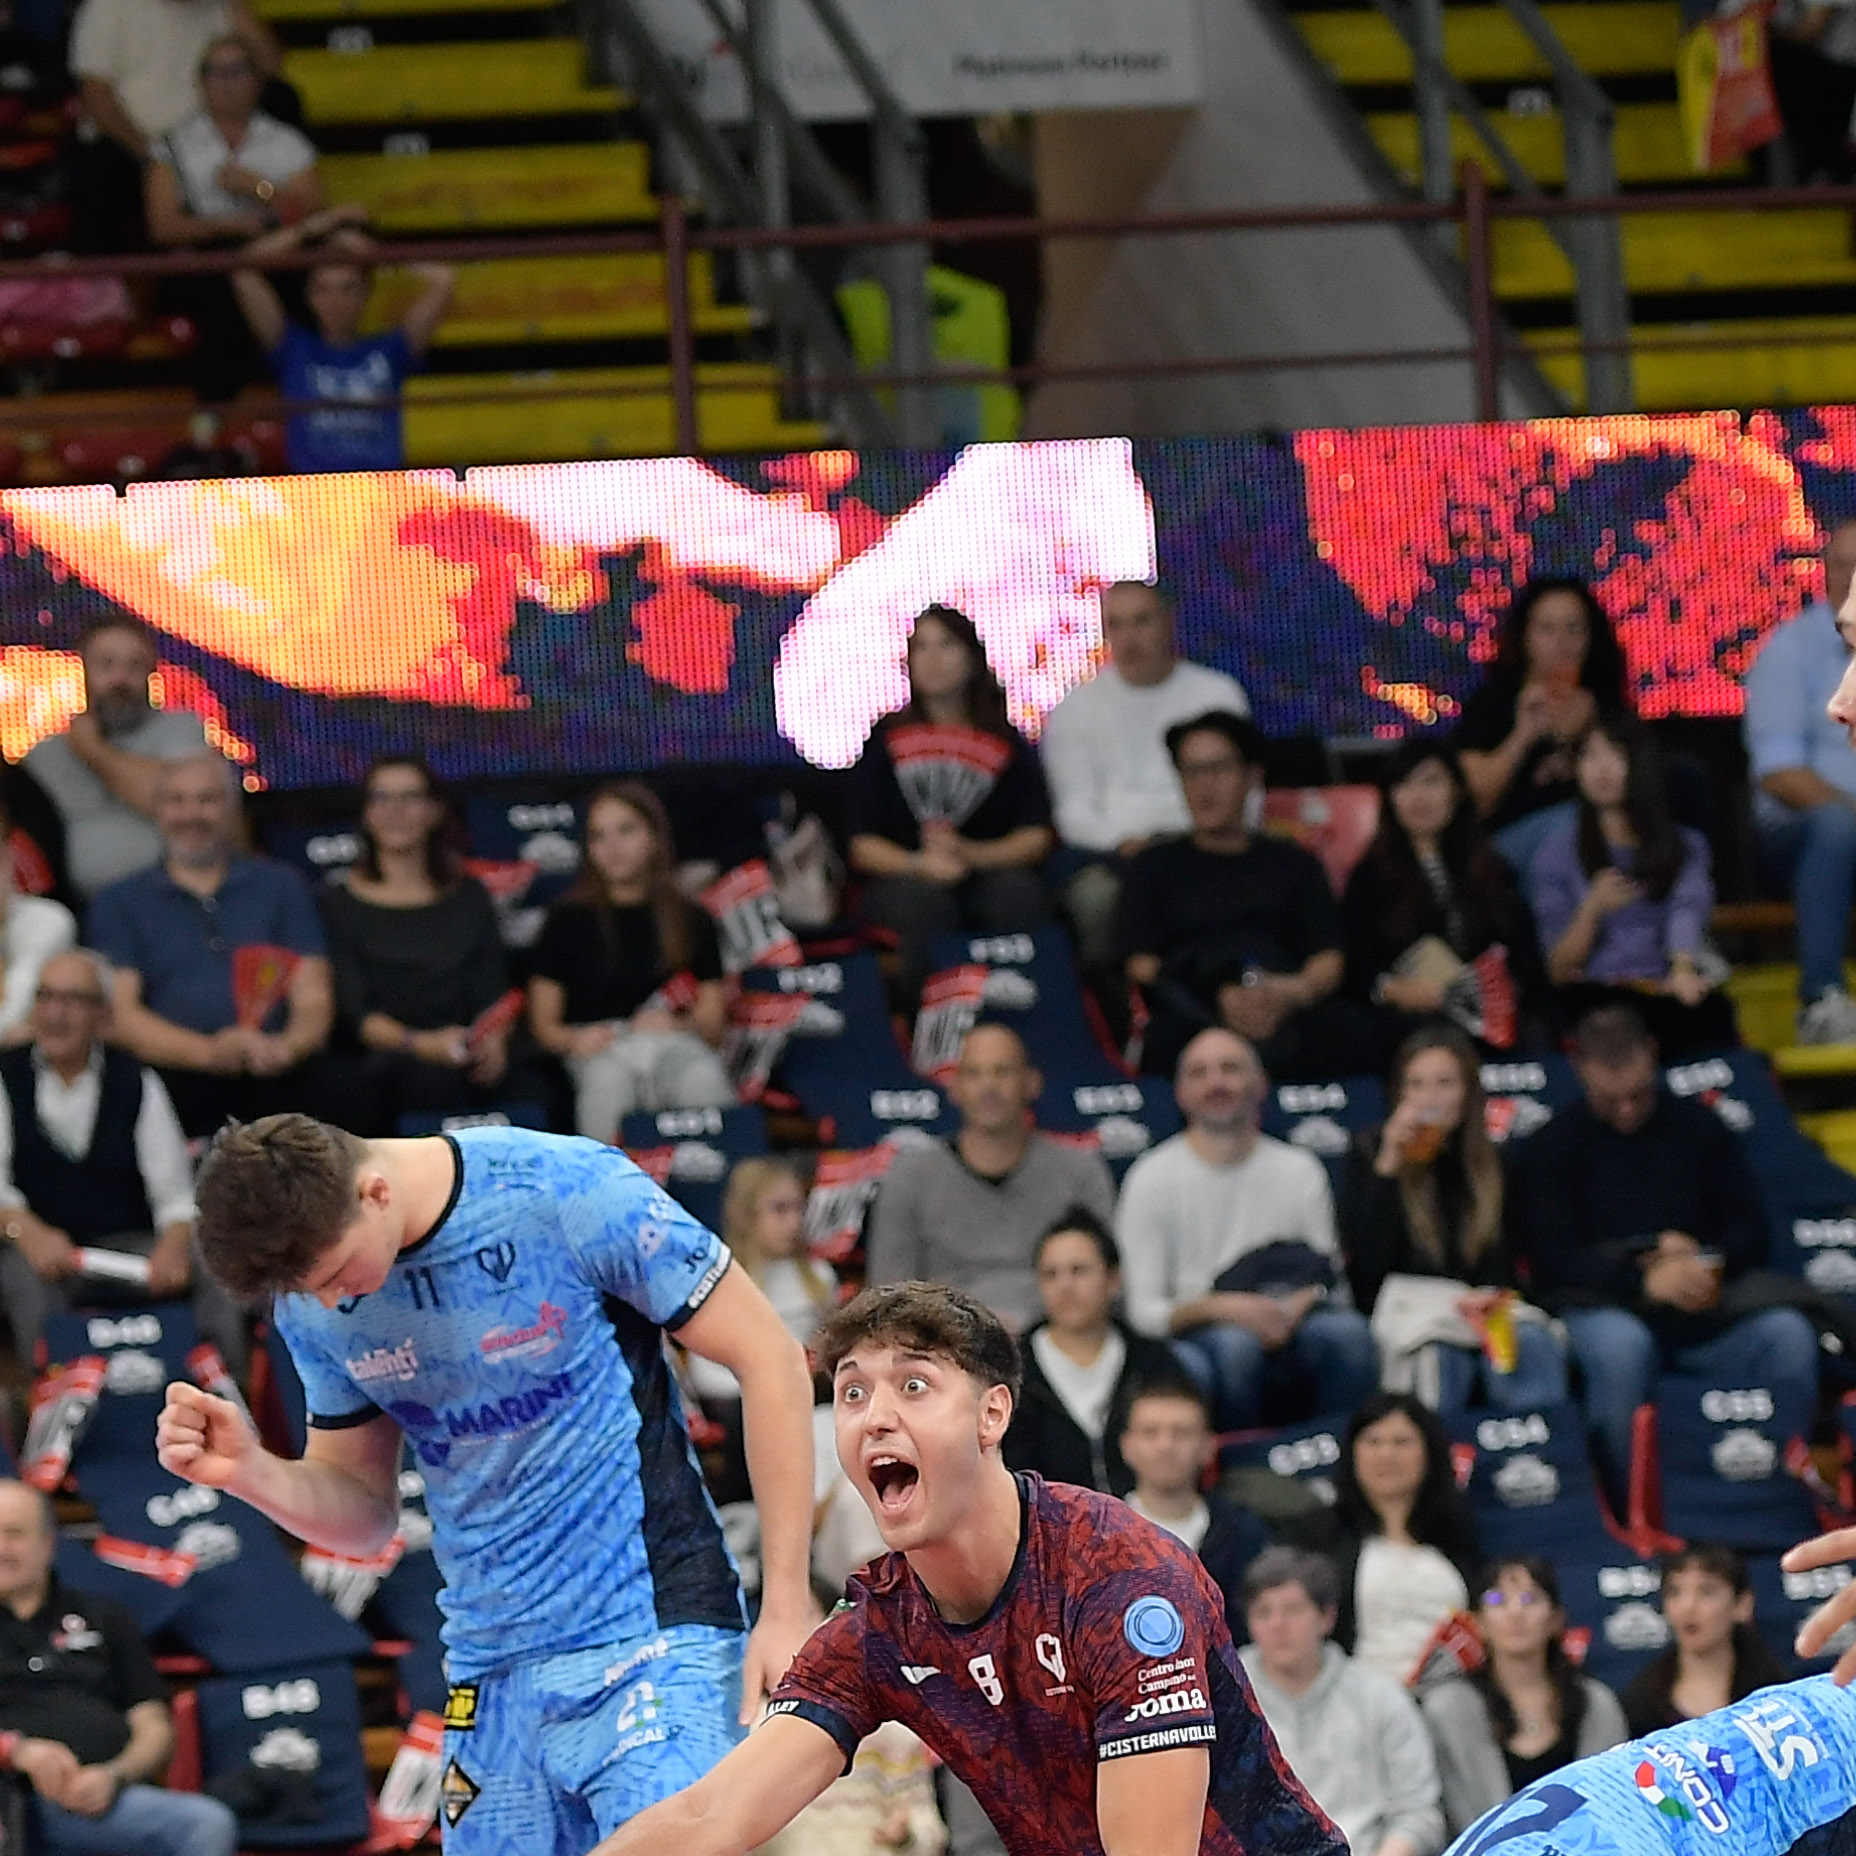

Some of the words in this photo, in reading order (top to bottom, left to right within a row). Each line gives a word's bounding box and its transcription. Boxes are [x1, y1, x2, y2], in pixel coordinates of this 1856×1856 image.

[403, 1266, 441, 1310] 11
[967, 1653, 1005, 1706] 8
[1123, 1687, 1207, 1722] Joma
